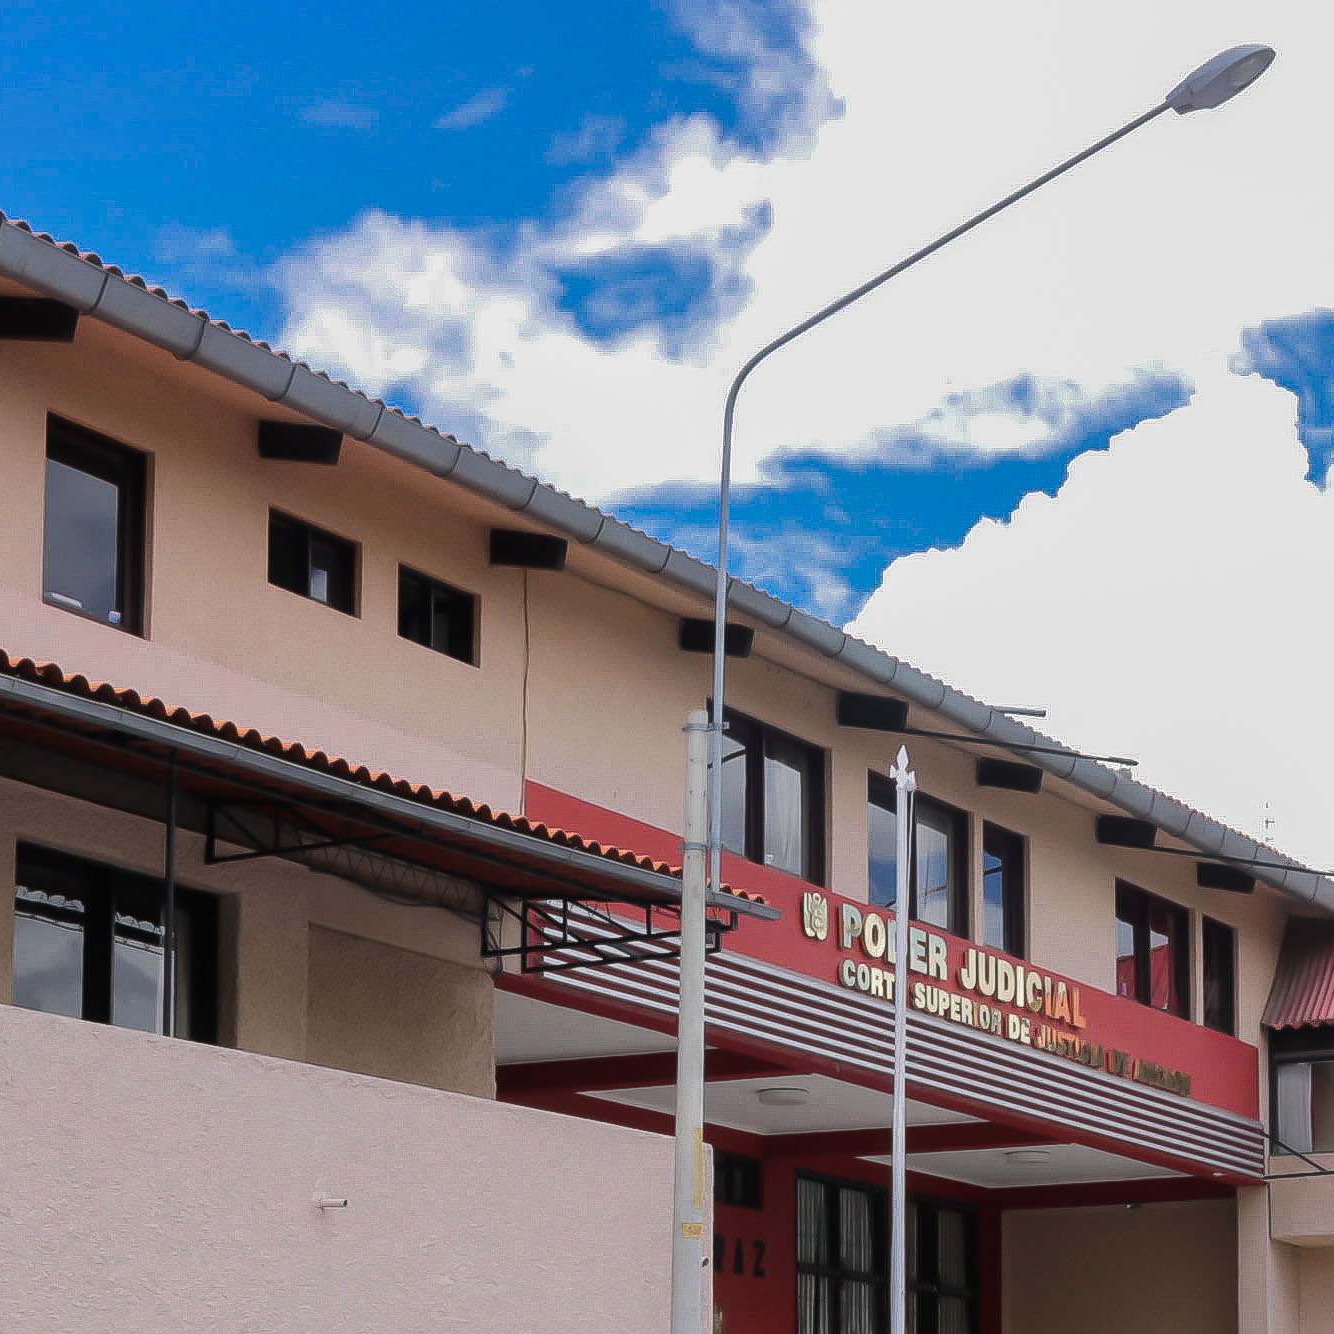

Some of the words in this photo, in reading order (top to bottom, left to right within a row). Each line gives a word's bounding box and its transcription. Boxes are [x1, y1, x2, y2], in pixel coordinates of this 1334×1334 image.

[841, 958, 898, 1001] CORT
[912, 981, 1002, 1036] SUPERIOR
[1007, 1012, 1032, 1045] DE
[958, 947, 1088, 1030] JUDICIAL
